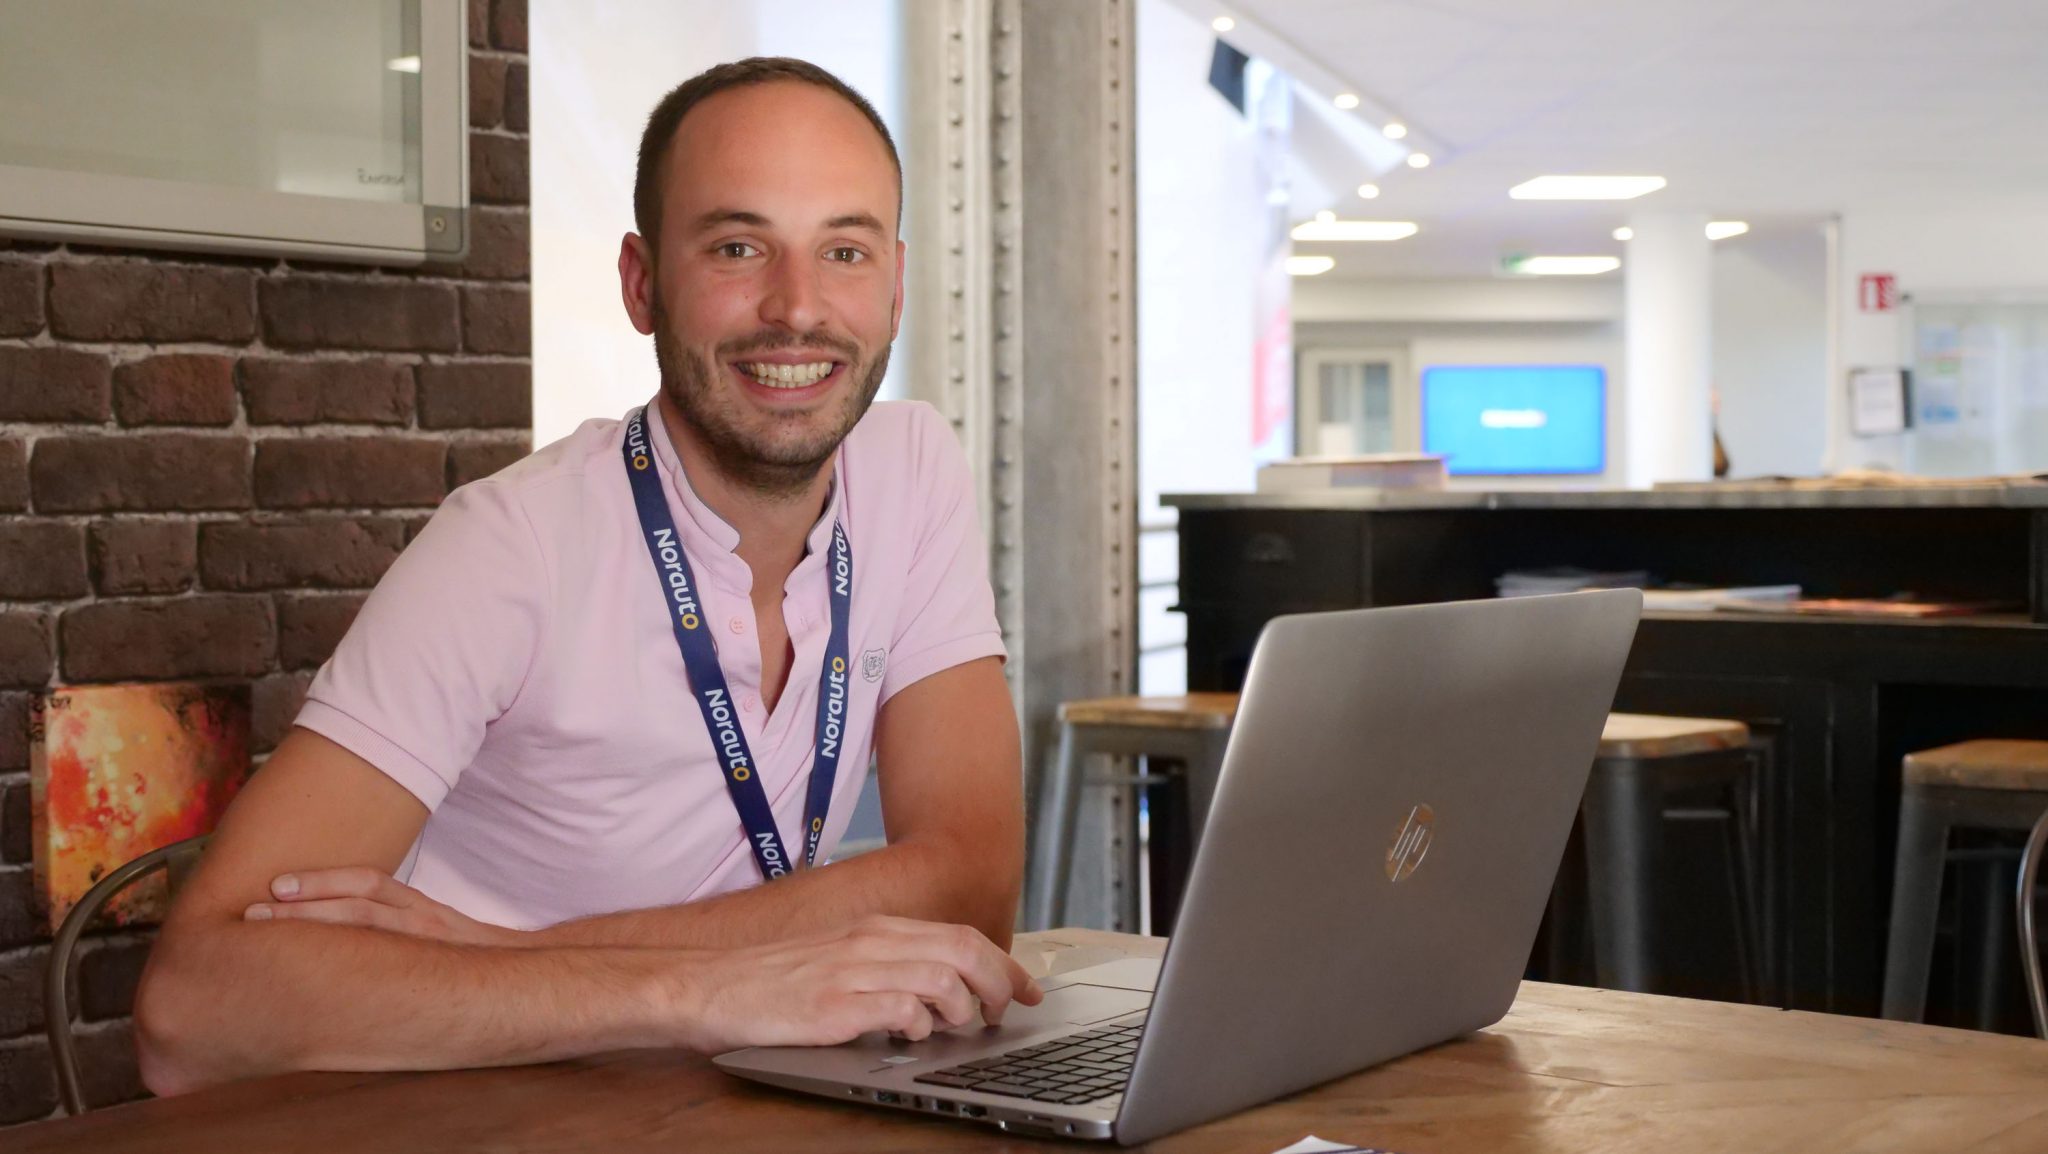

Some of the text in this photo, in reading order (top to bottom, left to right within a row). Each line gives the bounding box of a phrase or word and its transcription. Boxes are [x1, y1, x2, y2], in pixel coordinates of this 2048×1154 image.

[653, 528, 699, 630] Norauto
[835, 518, 849, 596] Norau
[704, 688, 750, 781] Norauto
[821, 656, 845, 758] Norauto
[807, 817, 821, 866] uto
[1388, 805, 1428, 882] hp
